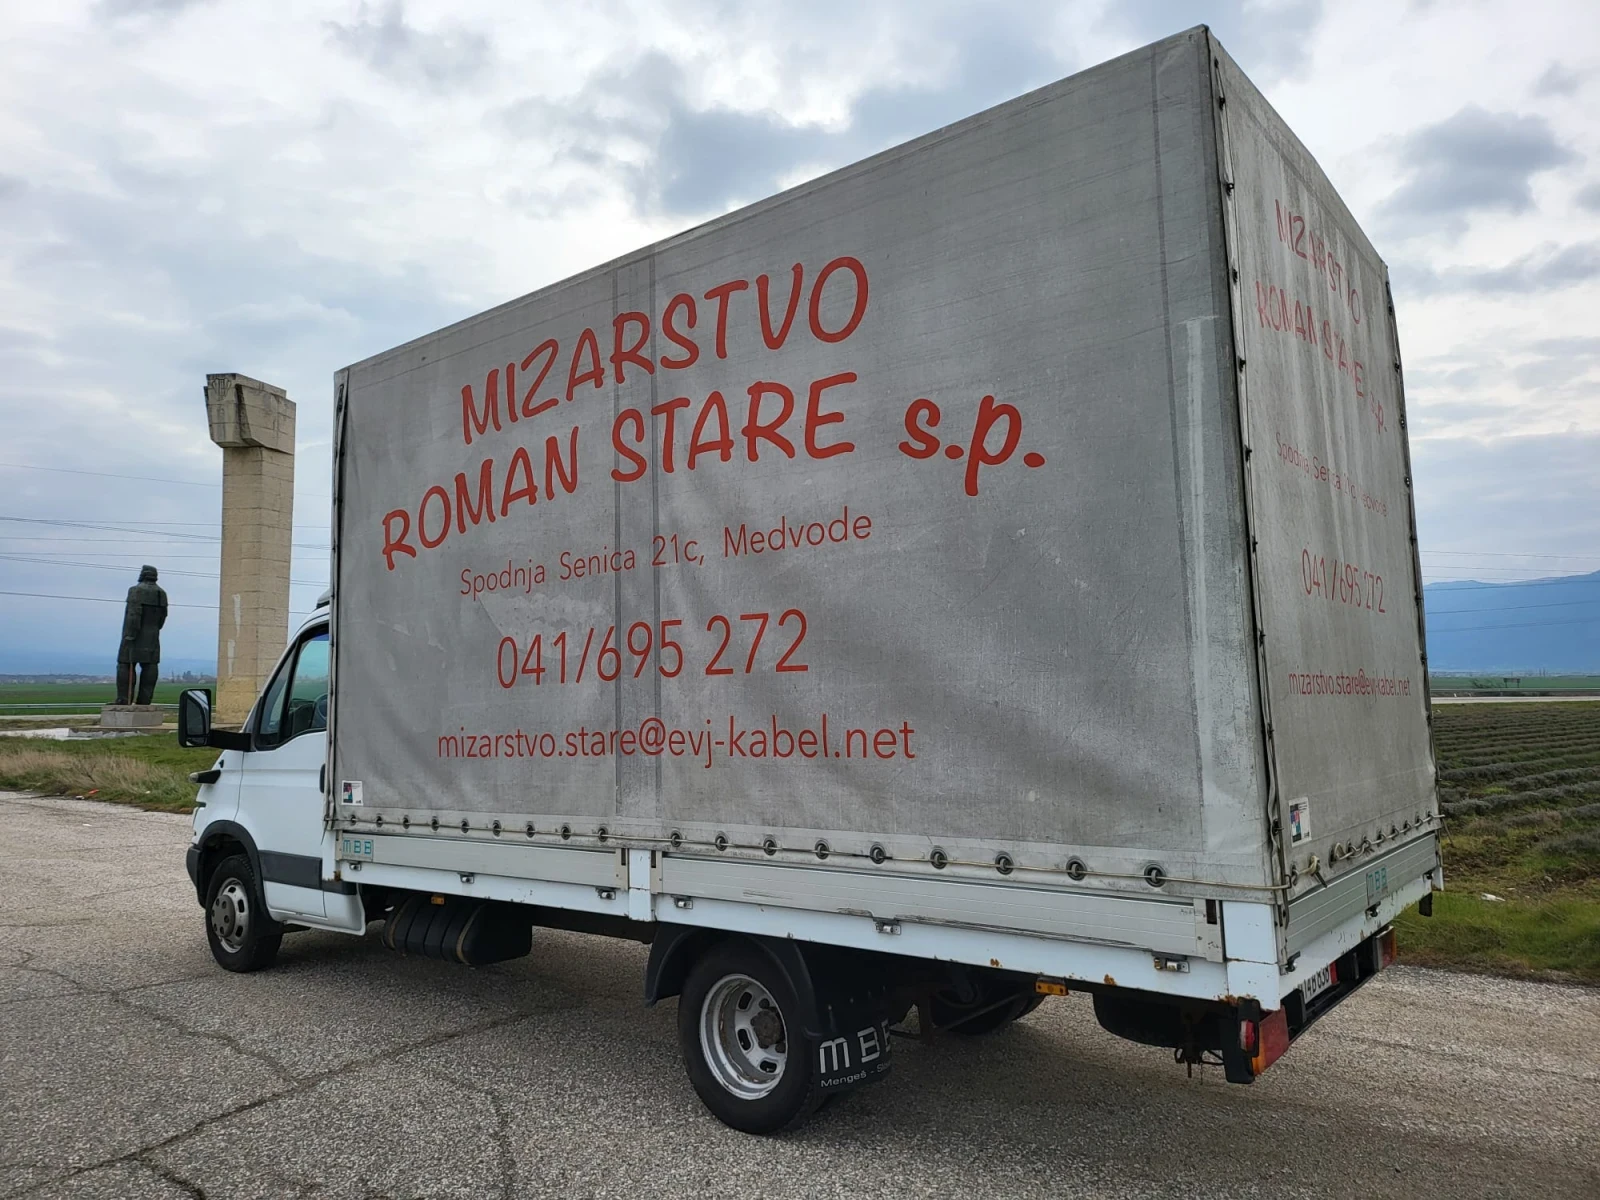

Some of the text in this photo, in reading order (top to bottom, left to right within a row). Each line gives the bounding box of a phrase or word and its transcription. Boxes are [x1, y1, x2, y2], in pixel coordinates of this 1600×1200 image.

[461, 256, 869, 445] MIZARSTVO
[382, 371, 1046, 571] ROMAN STARE s.p.
[461, 506, 873, 597] Spodnja Senica 21c, Medvode
[1302, 548, 1386, 614] 041/695 272
[497, 608, 810, 690] 041/695 272
[438, 714, 917, 770] mizarstvo.stare@evj-kabel.net
